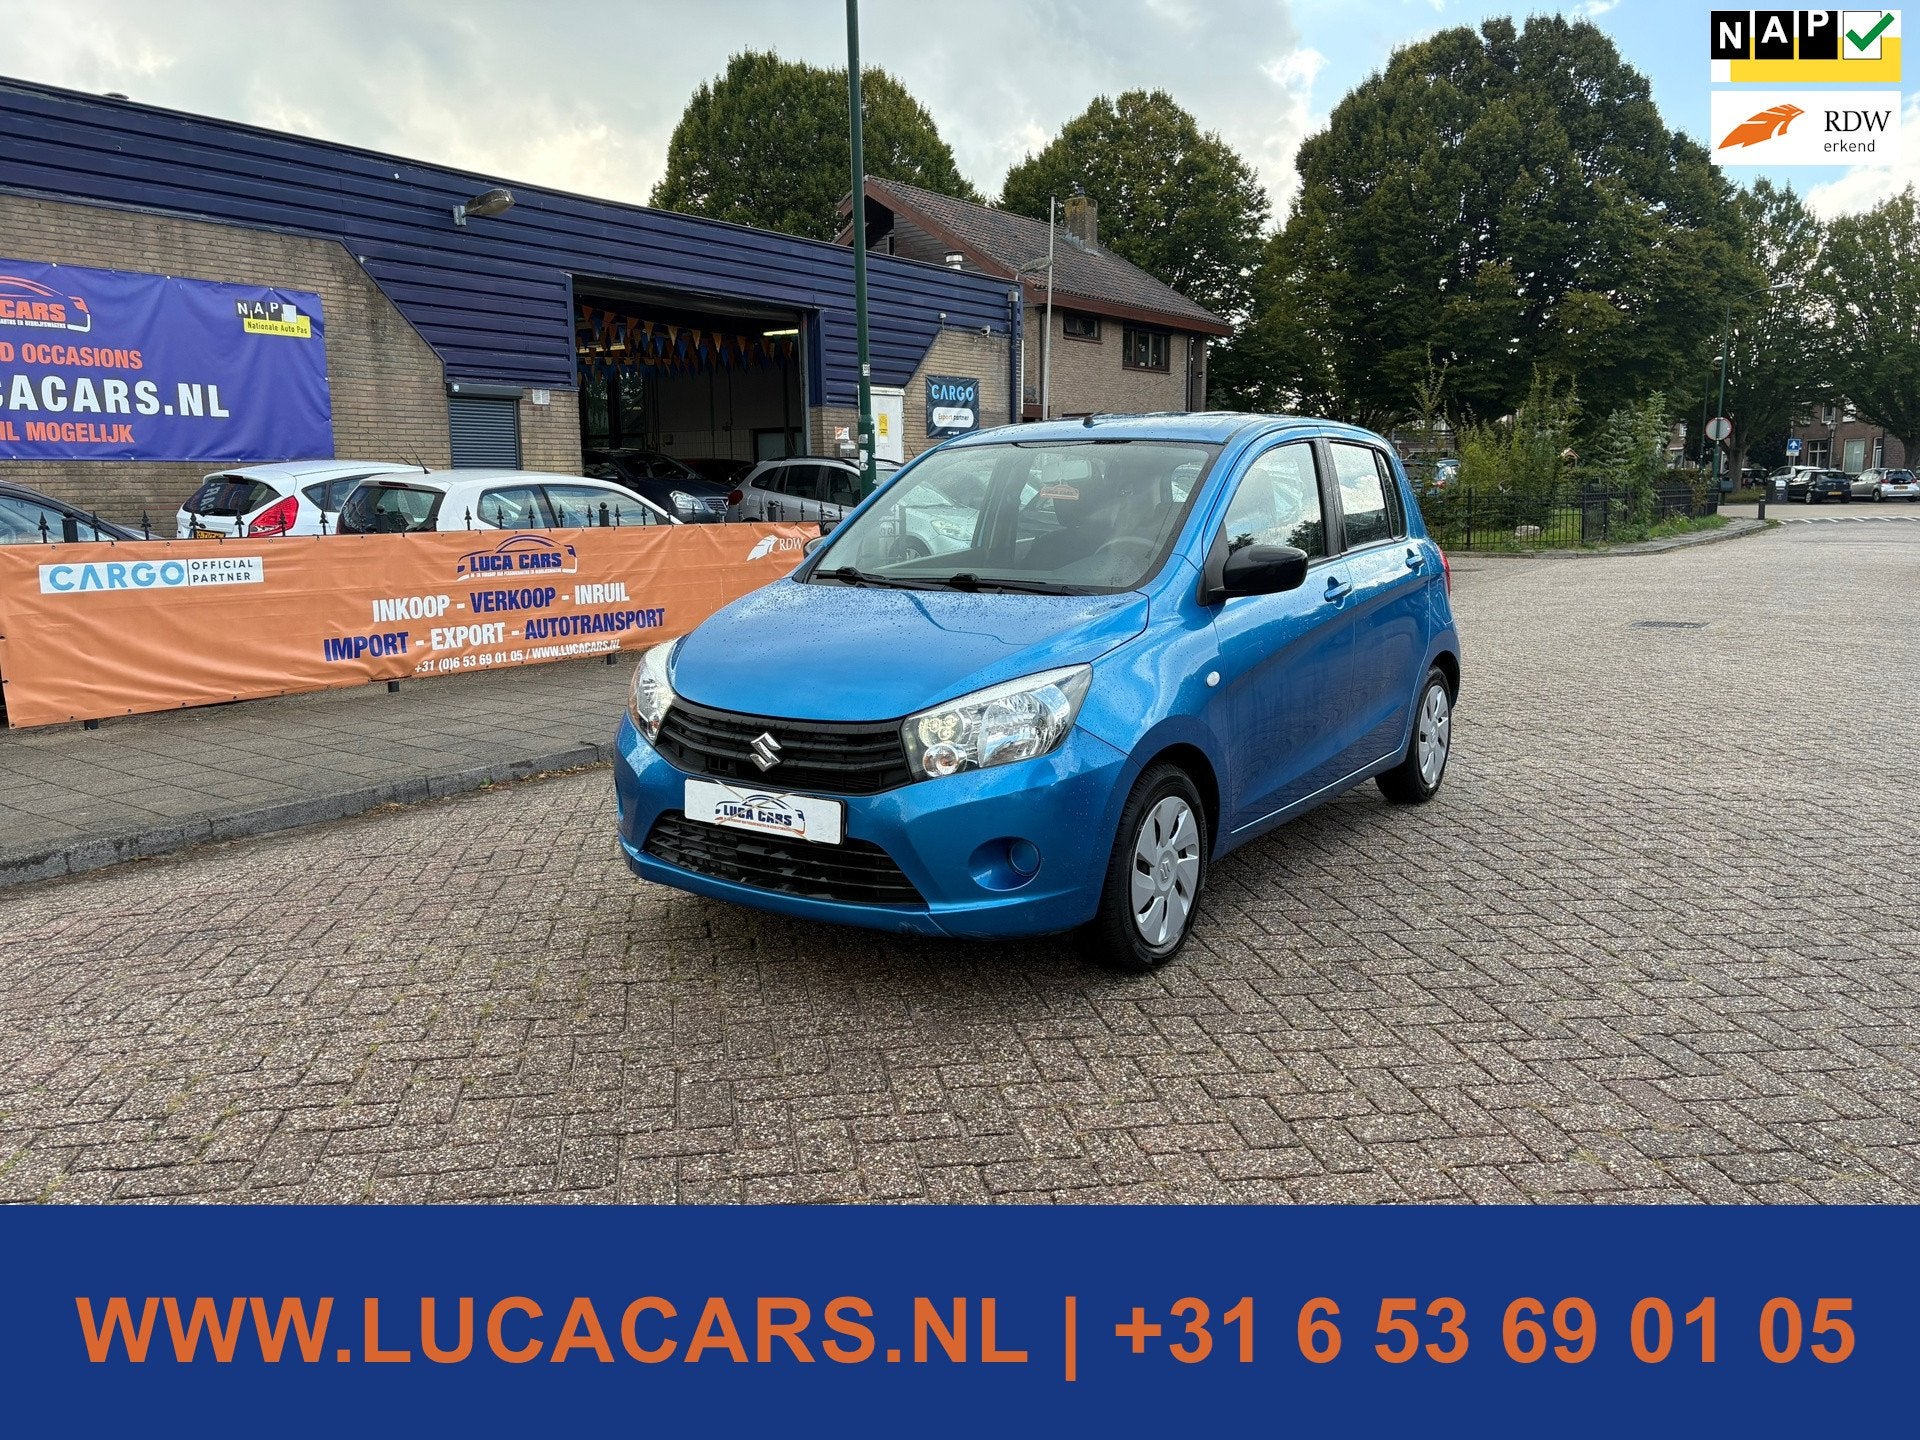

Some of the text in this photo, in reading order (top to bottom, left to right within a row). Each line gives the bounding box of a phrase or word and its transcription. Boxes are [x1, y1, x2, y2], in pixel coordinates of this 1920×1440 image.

[0, 299, 66, 322] CARS
[237, 302, 279, 315] NAP
[247, 321, 308, 334] Nationale Auto Pas
[21, 343, 143, 369] OCCASIONS
[0, 374, 230, 418] ACARS.NL
[931, 384, 974, 402] CARGO
[25, 421, 135, 443] MOGELIJK
[779, 537, 804, 551] RDW
[191, 558, 254, 571] OFFICIAL
[470, 554, 514, 573] LUCA
[518, 552, 562, 570] CARS
[48, 561, 186, 592] CARGO
[192, 571, 252, 584] PARTNER
[372, 594, 451, 623] INKOOP
[470, 586, 557, 613] VERKOOP
[574, 582, 630, 605] INRUIL
[323, 631, 409, 662] IMPORT
[430, 622, 505, 651] EXPORT
[524, 608, 666, 640] AUTOTRANSPORT
[414, 661, 435, 673] +31
[438, 656, 460, 672] (0)6
[462, 655, 477, 668] 53
[479, 653, 492, 665] 69
[494, 652, 507, 664] 01
[510, 650, 524, 662] 05
[532, 639, 621, 660] WWW.LUCACARS.NL
[723, 804, 754, 821] LUCA
[757, 809, 792, 827] CARS
